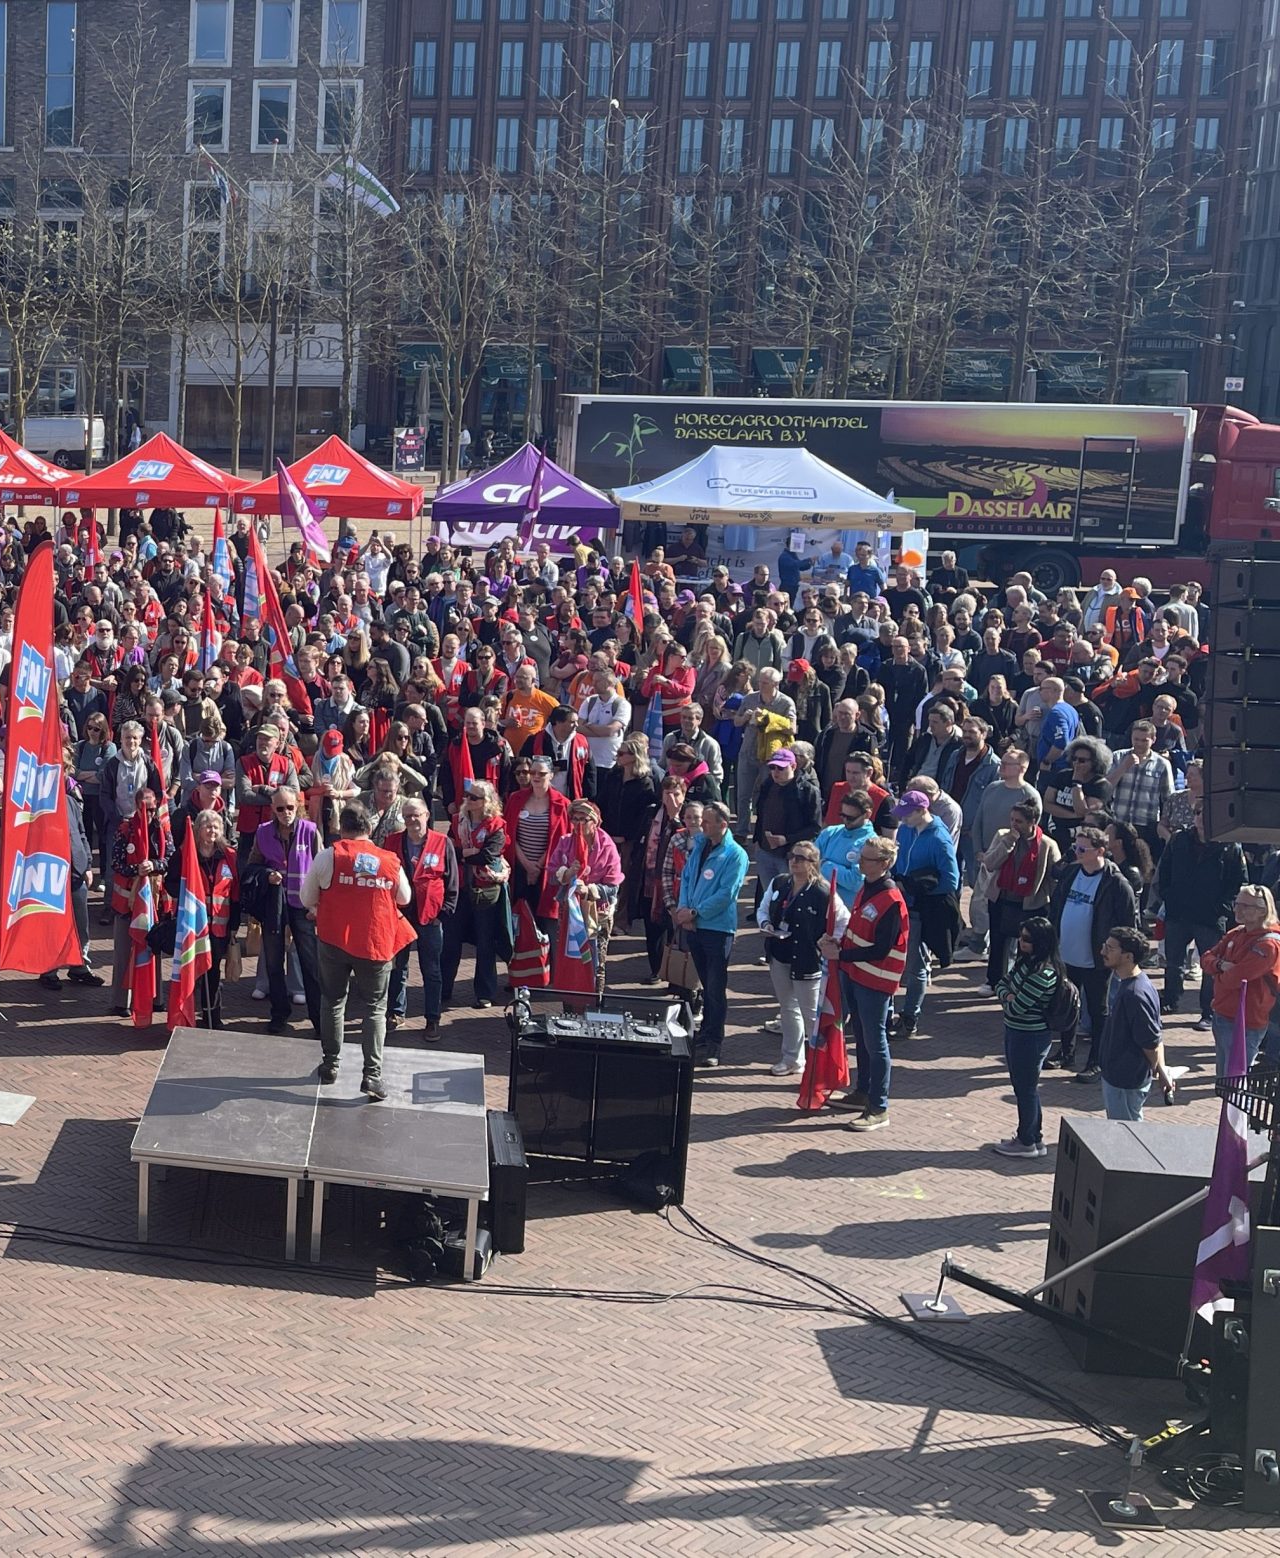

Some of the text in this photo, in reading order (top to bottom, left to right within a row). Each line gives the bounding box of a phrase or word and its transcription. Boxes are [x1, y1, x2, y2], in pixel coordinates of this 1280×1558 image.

[283, 339, 342, 360] FIDE
[674, 413, 868, 429] HORECAGROOTHANDEL
[674, 427, 807, 442] DASSELAAR B.V.
[133, 464, 171, 477] FNV
[308, 468, 347, 481] FNV
[206, 496, 220, 505] FNV
[946, 491, 1072, 519] DASSELAAR
[640, 504, 662, 513] NCF
[338, 872, 354, 884] in
